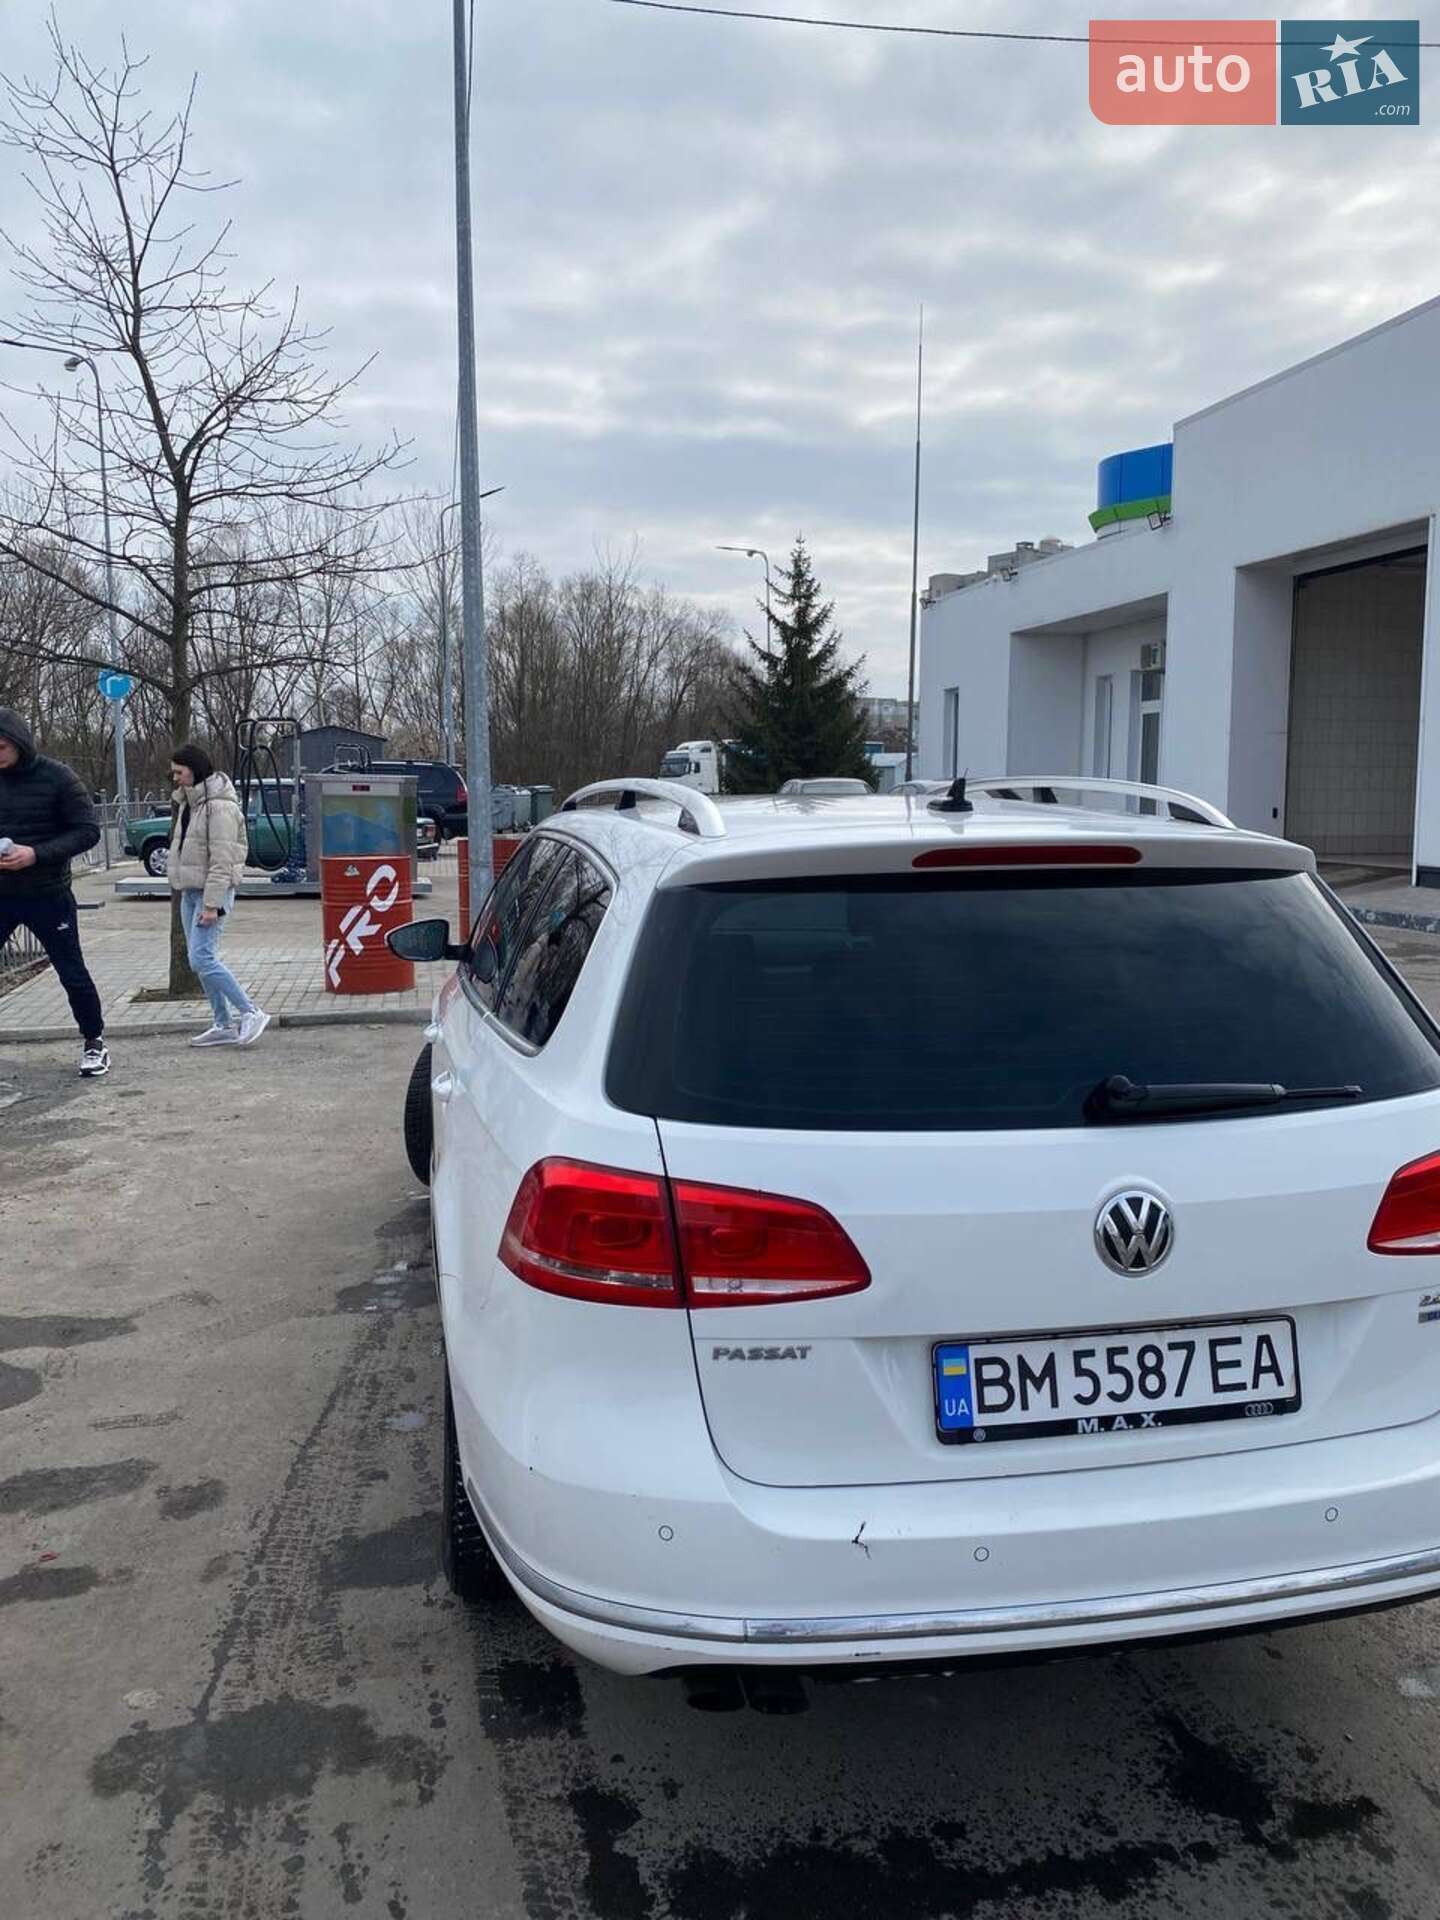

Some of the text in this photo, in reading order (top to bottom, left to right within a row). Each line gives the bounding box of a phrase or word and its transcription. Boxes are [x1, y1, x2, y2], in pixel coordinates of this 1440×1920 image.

[712, 1346, 812, 1360] PASSAT
[974, 1334, 1285, 1414] BM 5587 EA
[944, 1398, 970, 1416] UA
